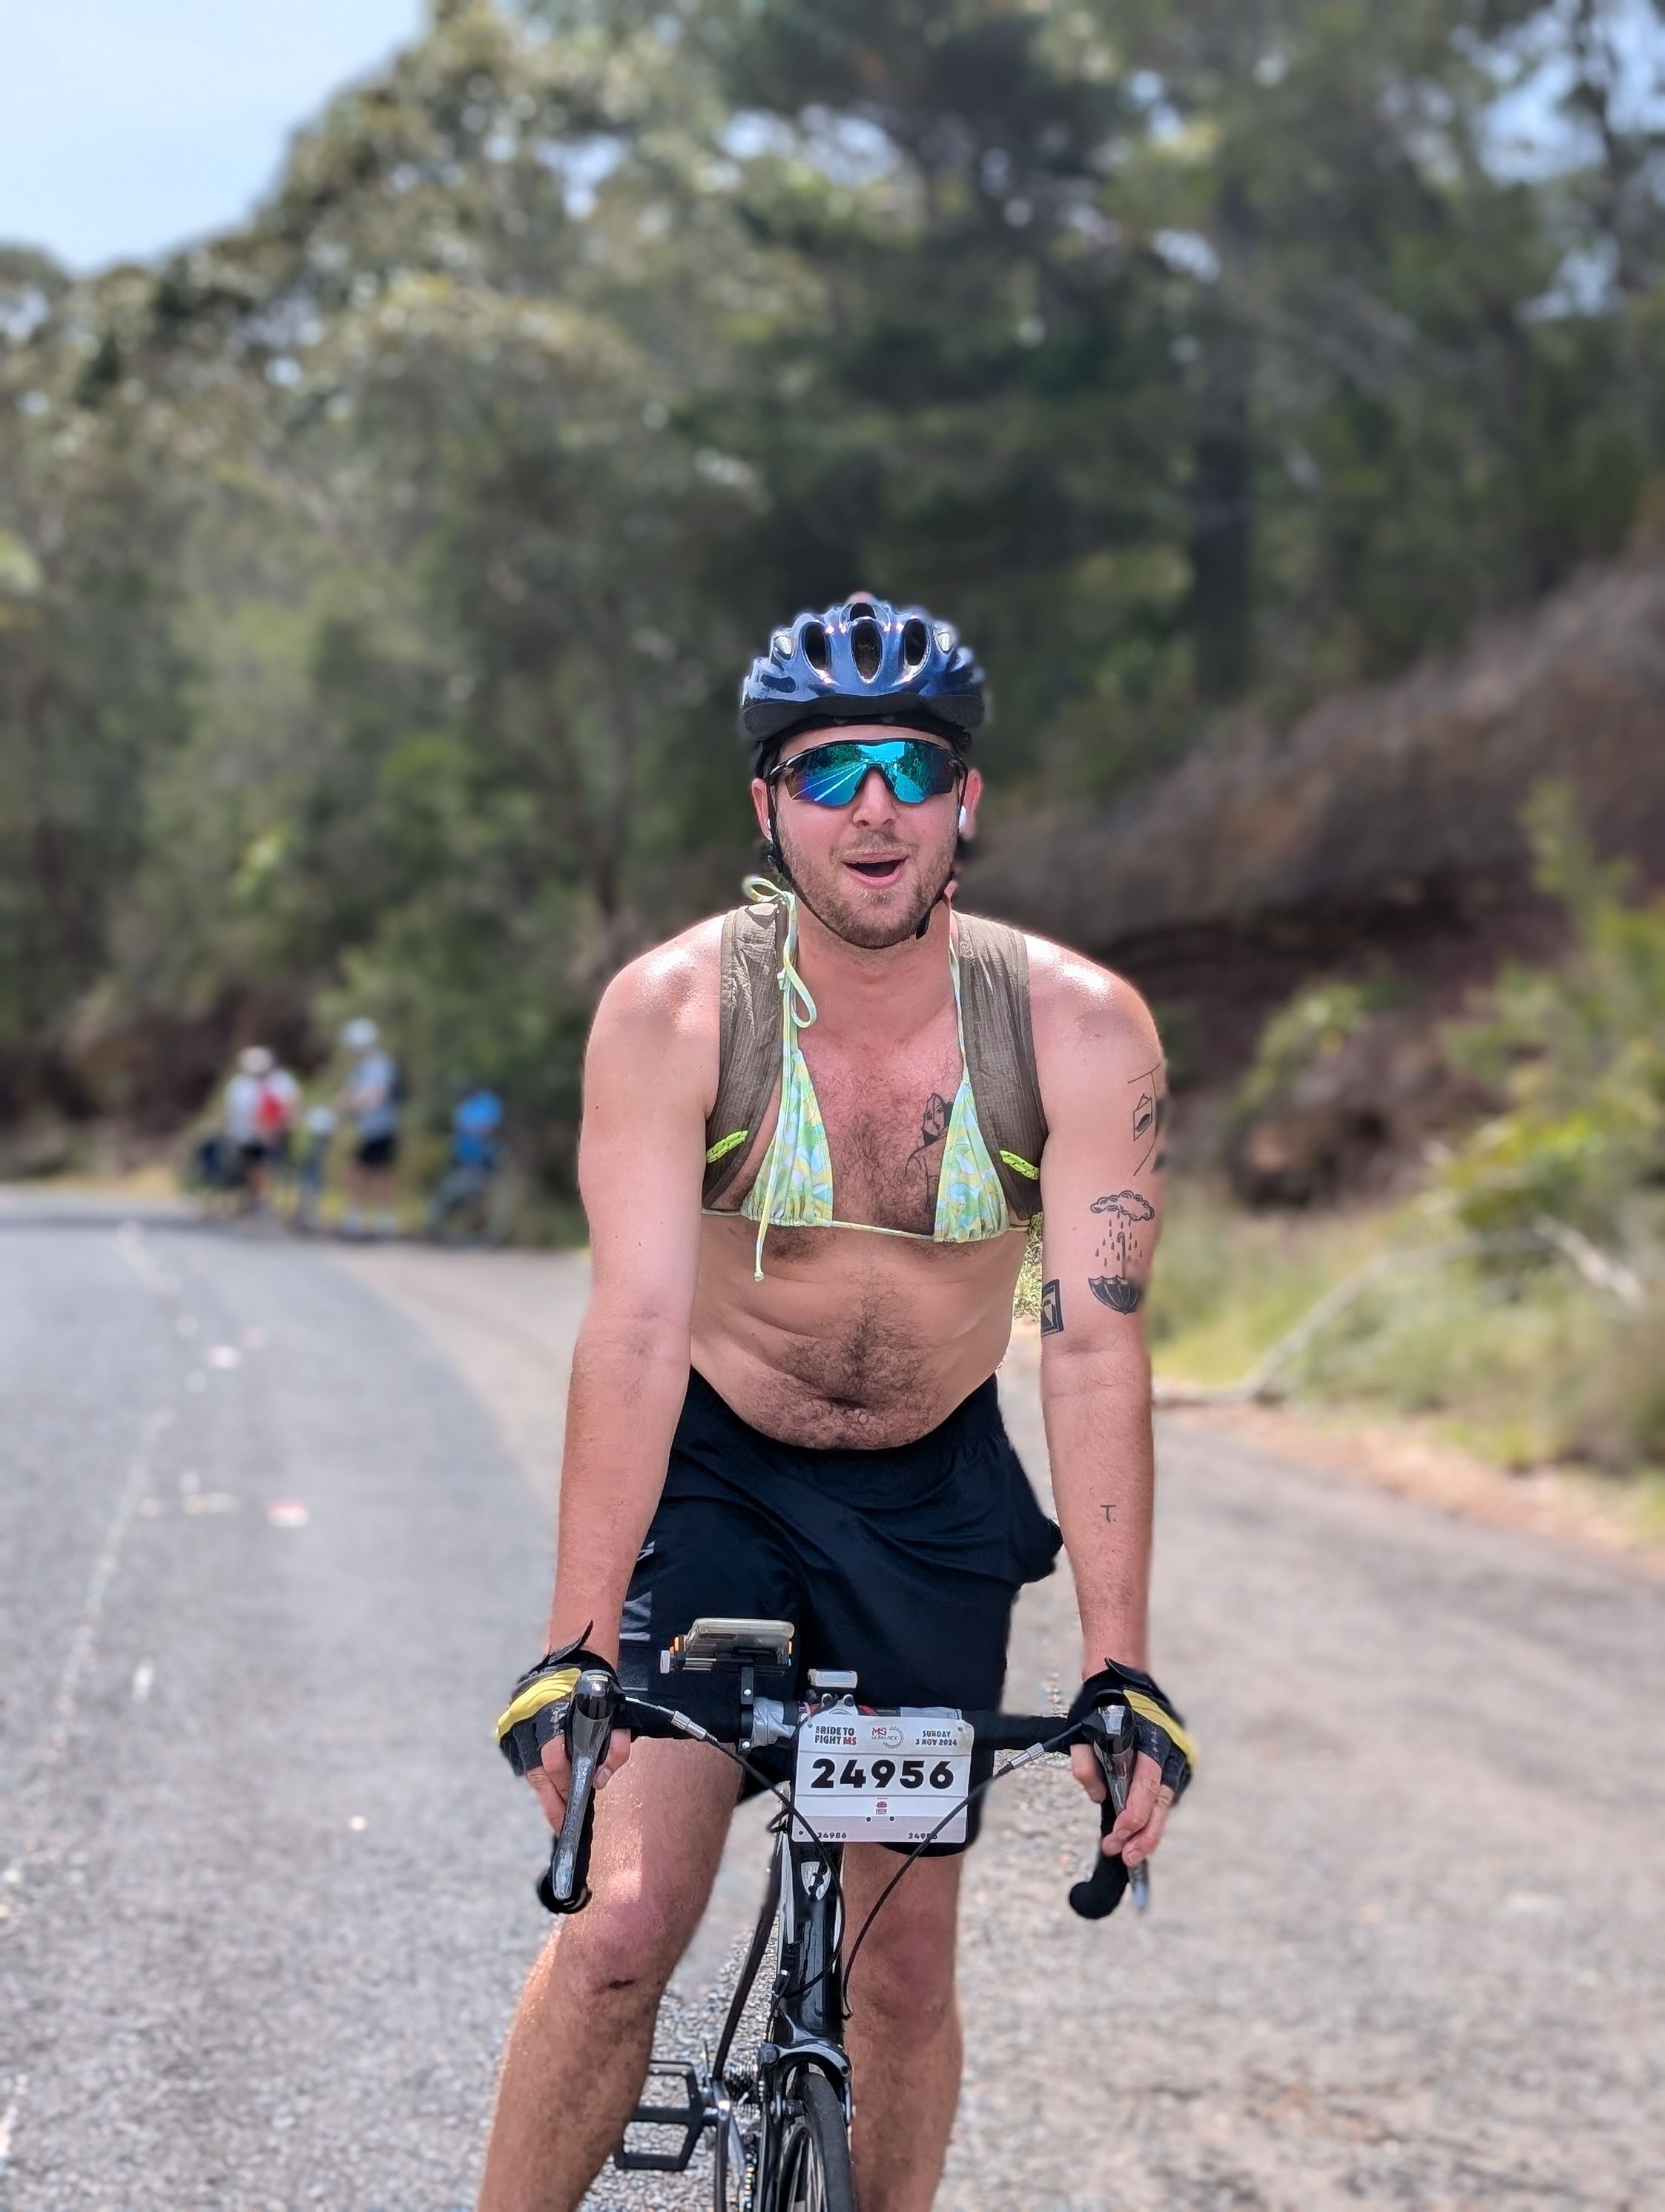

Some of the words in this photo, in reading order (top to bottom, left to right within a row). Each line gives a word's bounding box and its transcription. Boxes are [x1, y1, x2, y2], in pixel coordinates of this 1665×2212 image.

[843, 1727, 855, 1737] TO
[922, 1730, 951, 1738] SUNDAY
[814, 1734, 842, 1745] FIGHT
[843, 1736, 857, 1745] MS
[811, 1758, 955, 1789] 24956
